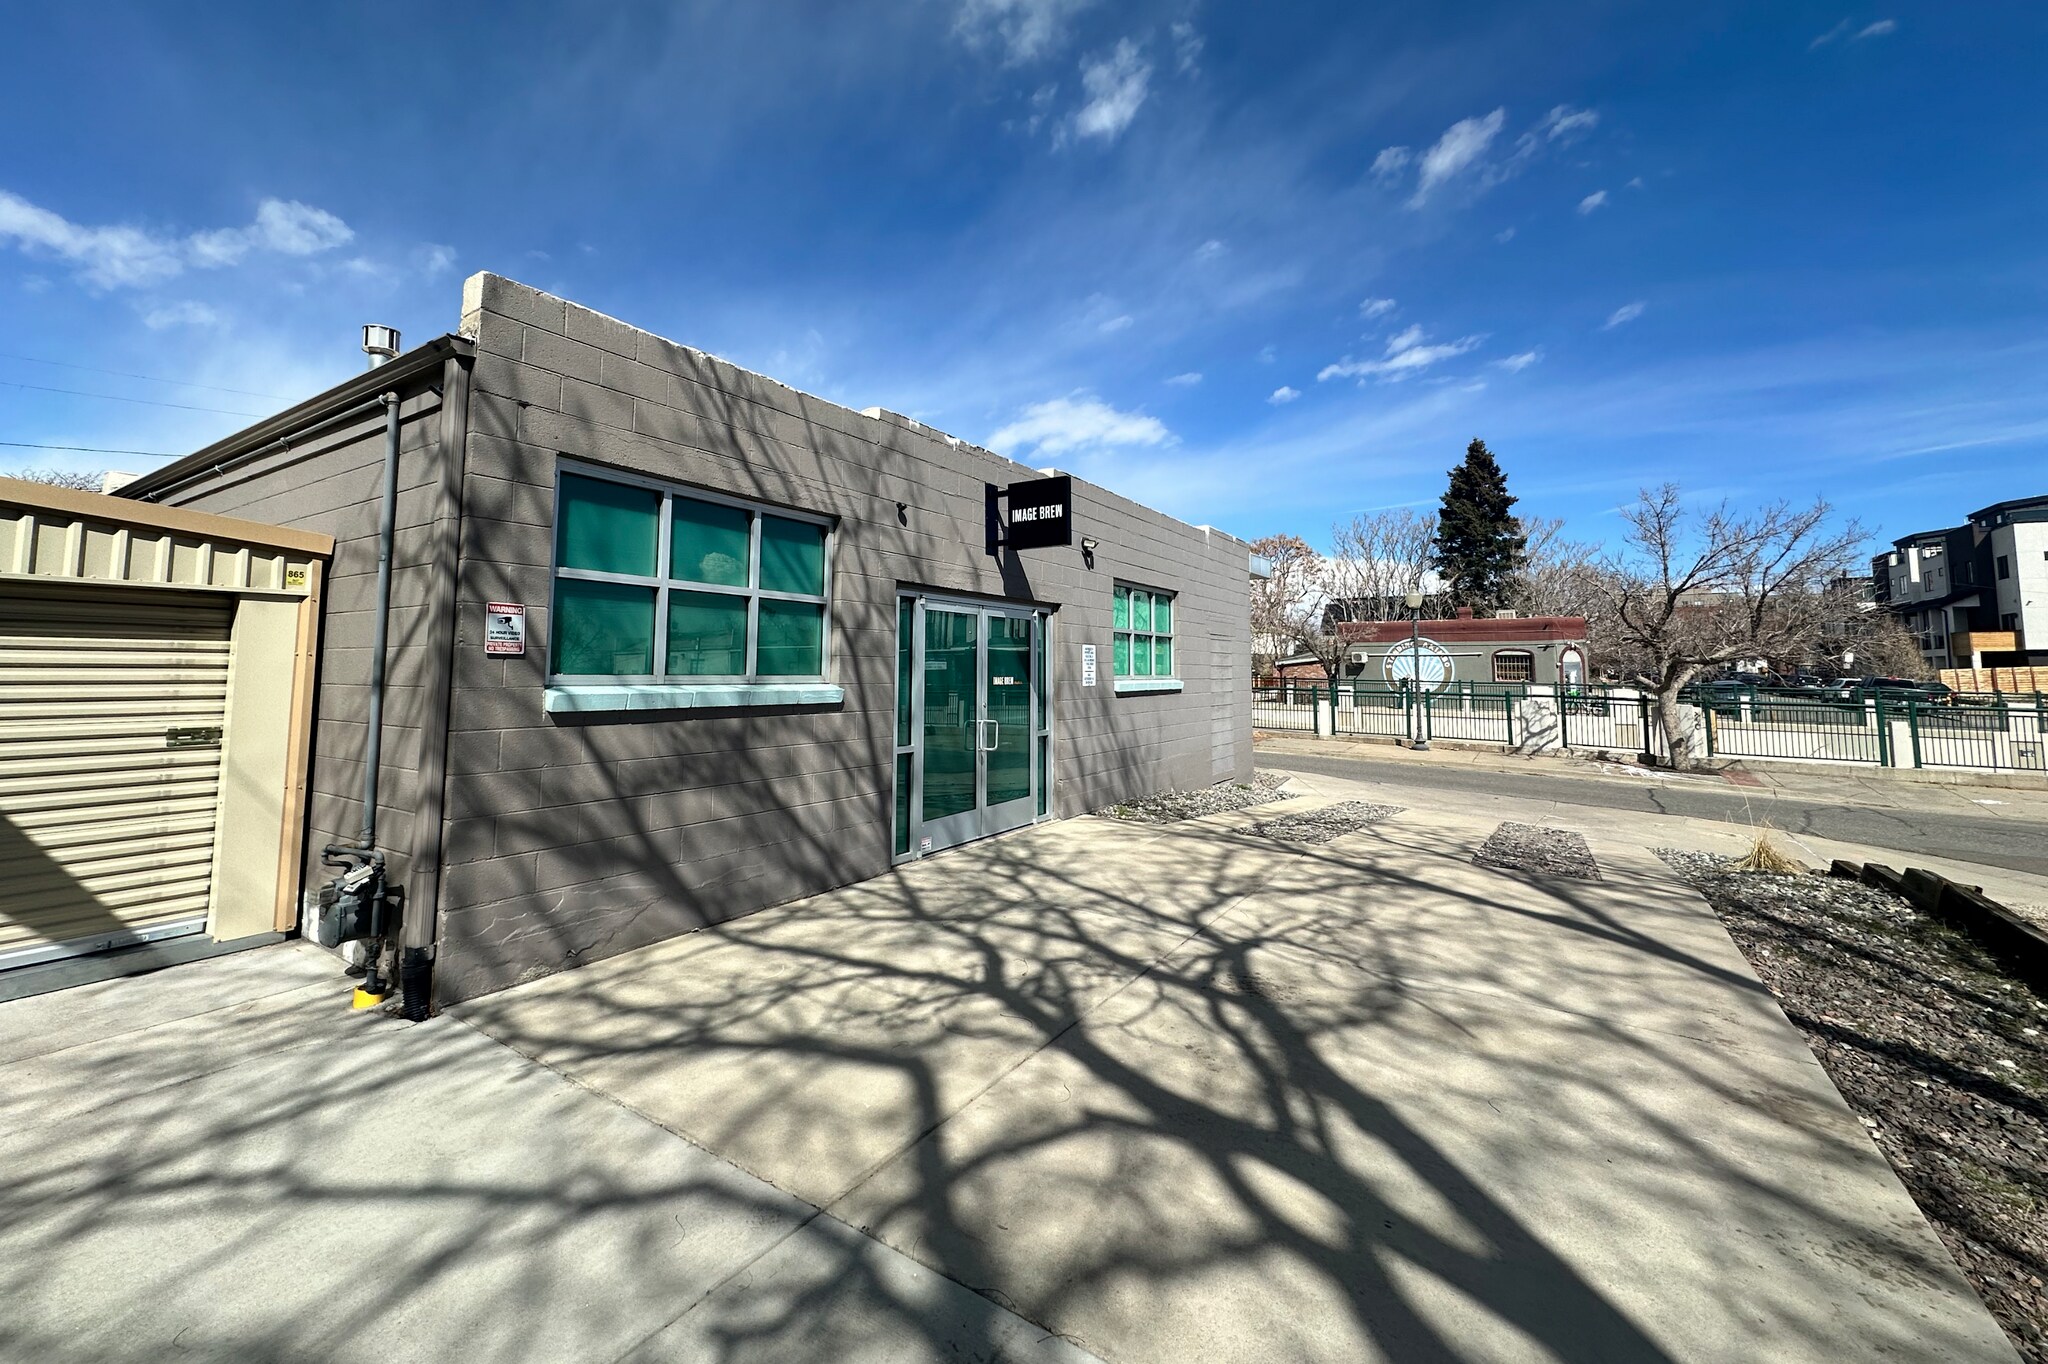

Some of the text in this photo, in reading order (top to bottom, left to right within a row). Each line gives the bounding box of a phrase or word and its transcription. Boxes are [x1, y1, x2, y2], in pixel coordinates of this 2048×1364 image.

[1012, 504, 1062, 523] IMAGE BREW
[288, 570, 304, 578] 865
[489, 605, 522, 614] WARNING
